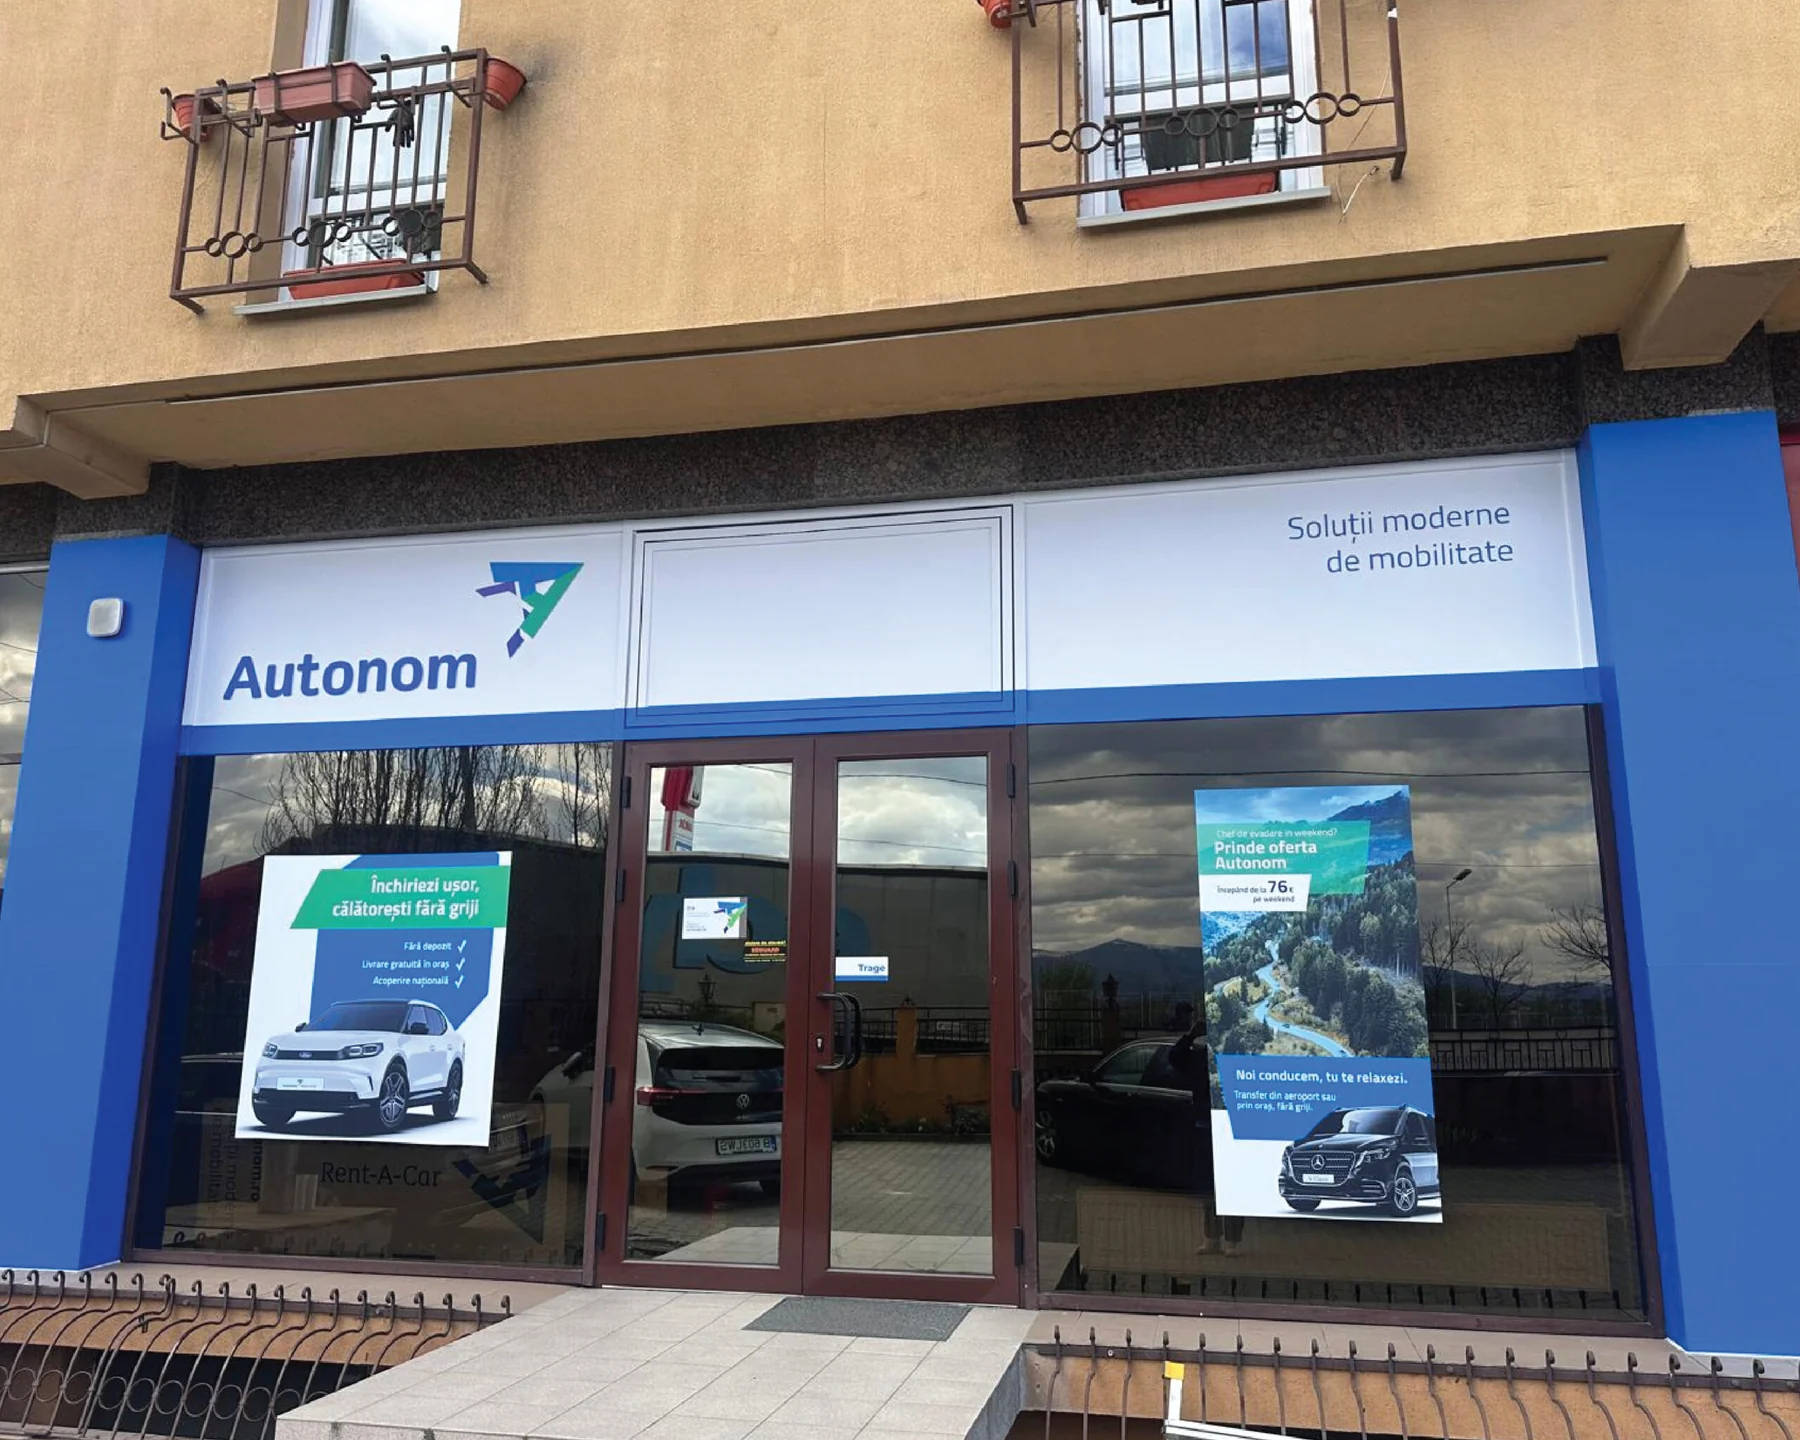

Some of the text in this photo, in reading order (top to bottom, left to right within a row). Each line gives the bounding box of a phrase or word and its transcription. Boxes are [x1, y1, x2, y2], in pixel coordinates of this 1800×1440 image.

[1287, 505, 1511, 544] Soluții moderne
[1326, 541, 1514, 573] de mobilitate
[223, 653, 478, 701] Autonom
[1236, 829, 1248, 838] de
[1294, 828, 1338, 838] weekend?
[1214, 841, 1318, 854] Prinde oferta
[1215, 857, 1287, 870] Autonom
[370, 874, 480, 897] Închiriezi ușor,
[1267, 880, 1288, 893] 76
[1252, 896, 1262, 904] pe
[332, 899, 480, 922] călătorești fără griji
[422, 942, 452, 952] depozit
[361, 960, 389, 969] Livrare
[857, 963, 886, 974] Trage
[372, 975, 411, 988] Acoperire
[1236, 1069, 1408, 1084] Noi conducem, tu te relaxezi.
[1233, 1090, 1337, 1103] Transfer din aeroport sau
[1236, 1102, 1254, 1111] prin
[1276, 1102, 1294, 1111] fără
[320, 1162, 442, 1187] Rent-A-Car
